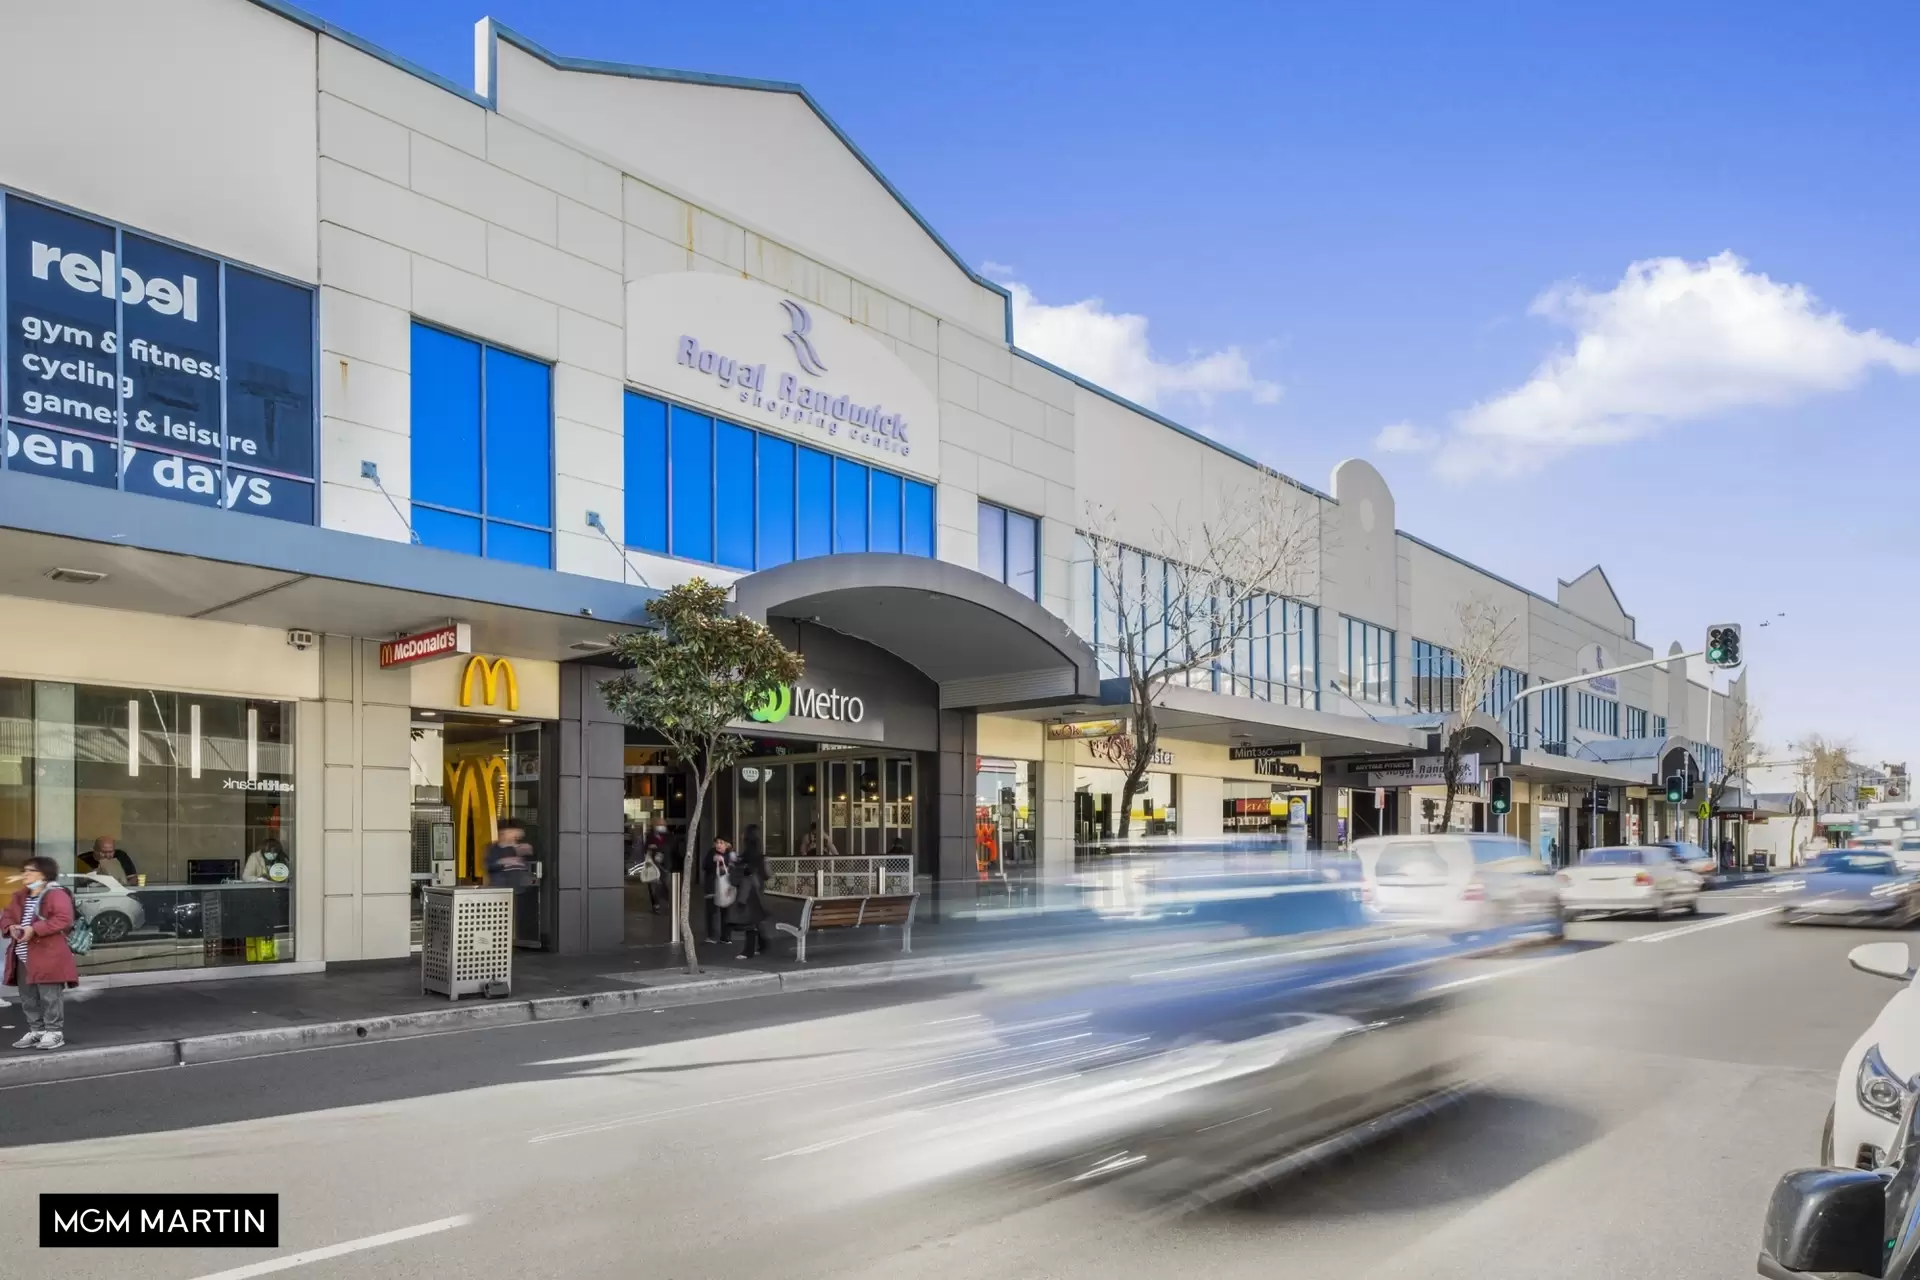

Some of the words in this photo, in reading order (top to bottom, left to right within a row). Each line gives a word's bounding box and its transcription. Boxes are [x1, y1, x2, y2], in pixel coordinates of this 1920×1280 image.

[31, 240, 198, 323] rebel
[21, 316, 93, 349] gym
[100, 331, 117, 354] &
[129, 338, 228, 381] fitness
[22, 353, 134, 398] cycling
[676, 334, 766, 392] Royal
[778, 372, 909, 443] Randwick
[22, 390, 129, 426] games
[135, 411, 156, 434] &
[163, 415, 258, 455] leisure
[739, 390, 838, 436] shopping
[849, 427, 911, 456] centre
[153, 456, 272, 509] days
[394, 631, 456, 660] McDonald's
[794, 687, 864, 723] Metro
[1149, 752, 1176, 765] aster
